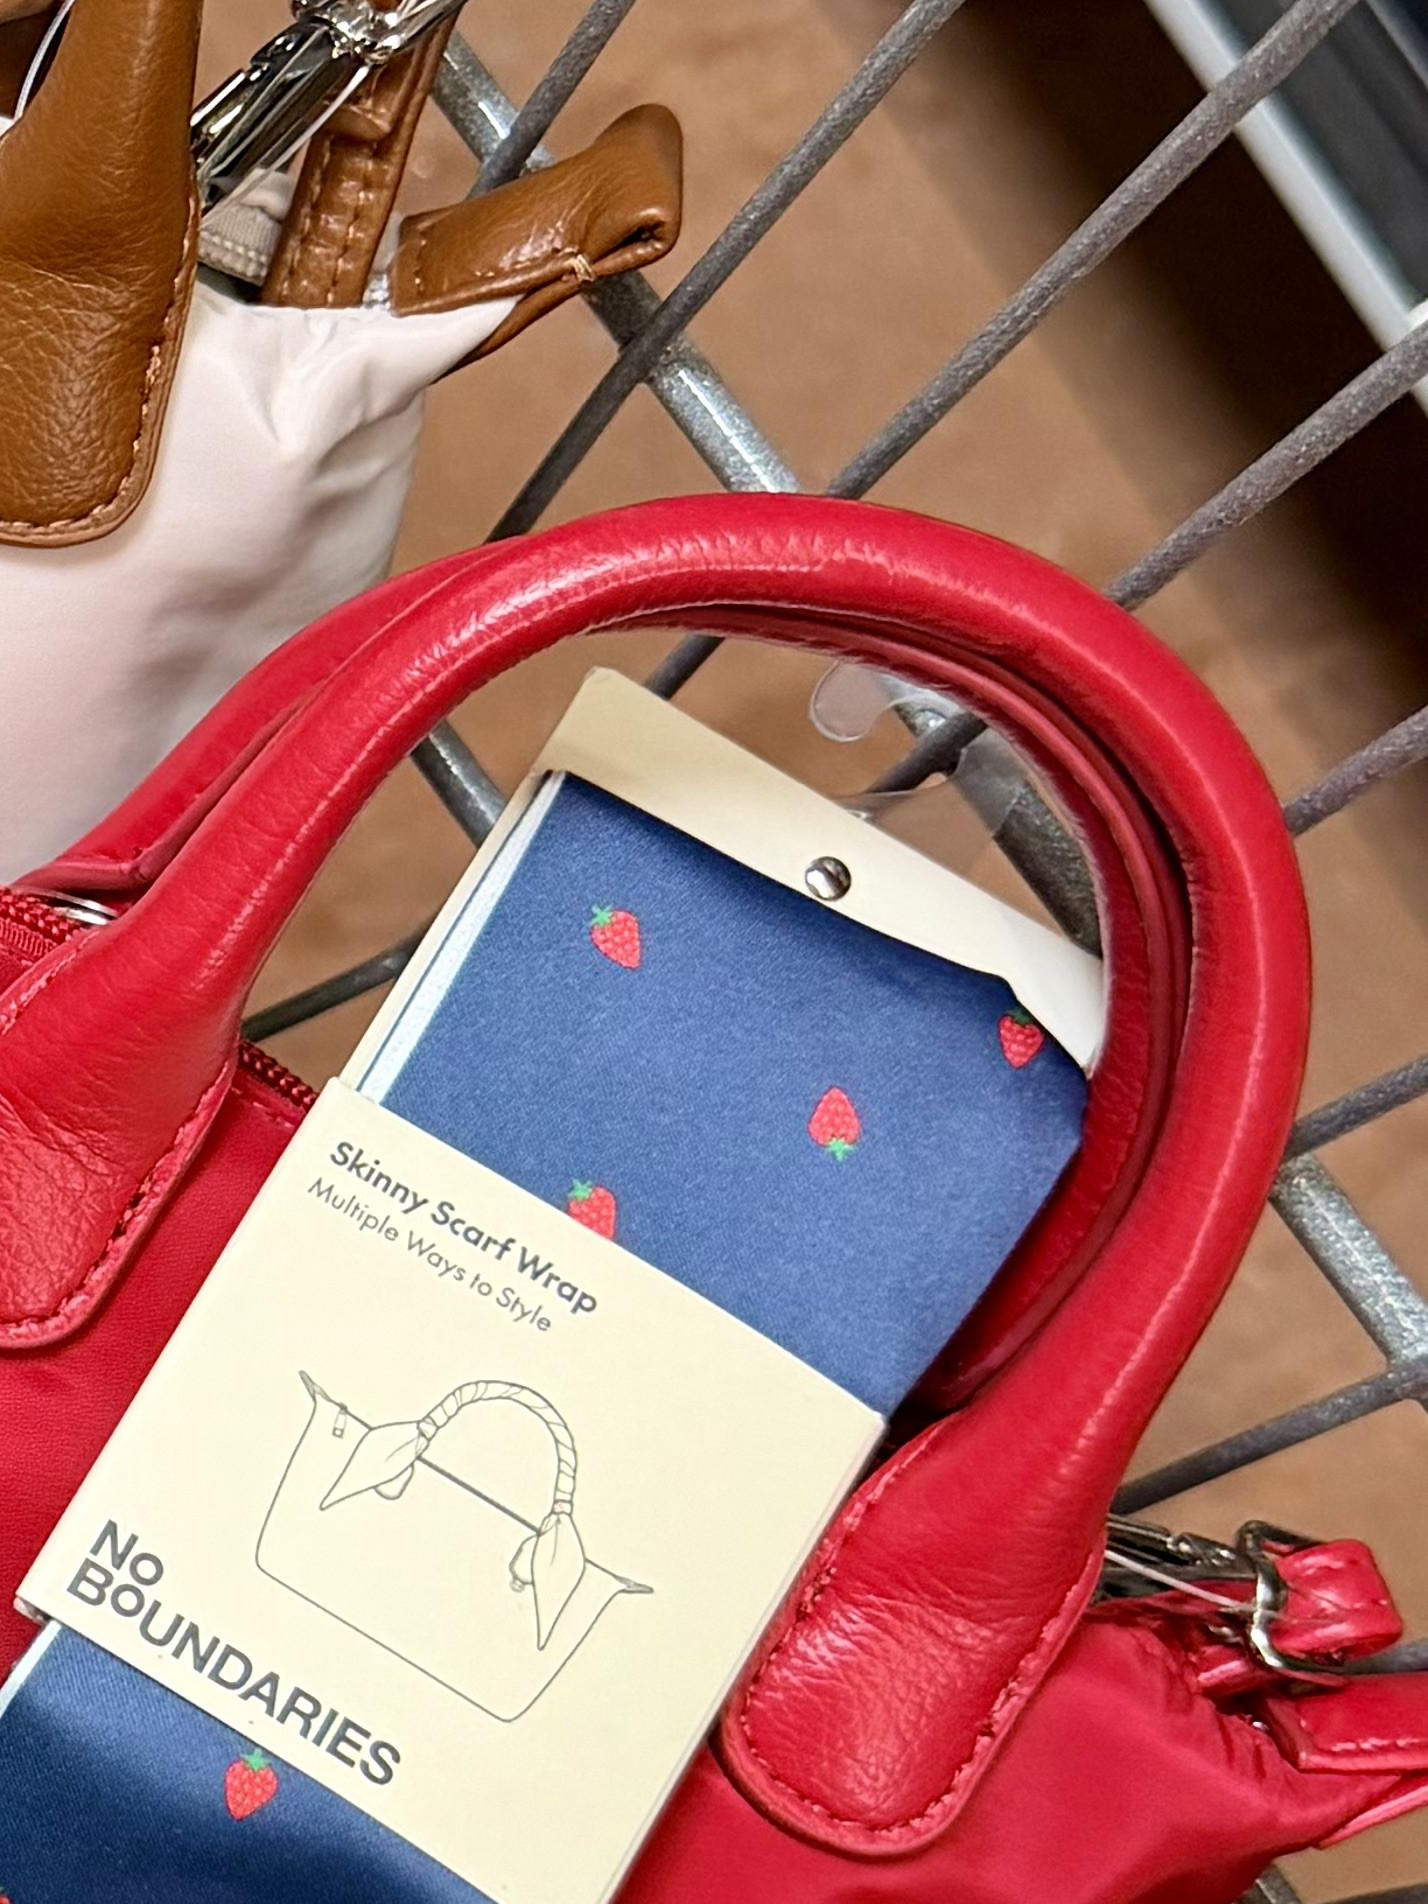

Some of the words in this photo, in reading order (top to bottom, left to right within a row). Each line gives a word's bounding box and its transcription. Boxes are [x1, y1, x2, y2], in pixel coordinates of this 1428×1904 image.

[308, 1177, 399, 1241] Multiple
[407, 1230, 467, 1281] Ways
[469, 1273, 493, 1296] to
[495, 1287, 551, 1332] Style
[330, 1141, 429, 1214] Skinny
[431, 1201, 516, 1260] Scarf
[517, 1246, 598, 1314] Wrap
[89, 1519, 164, 1586] NO
[67, 1557, 401, 1785] BOUNDARIES
